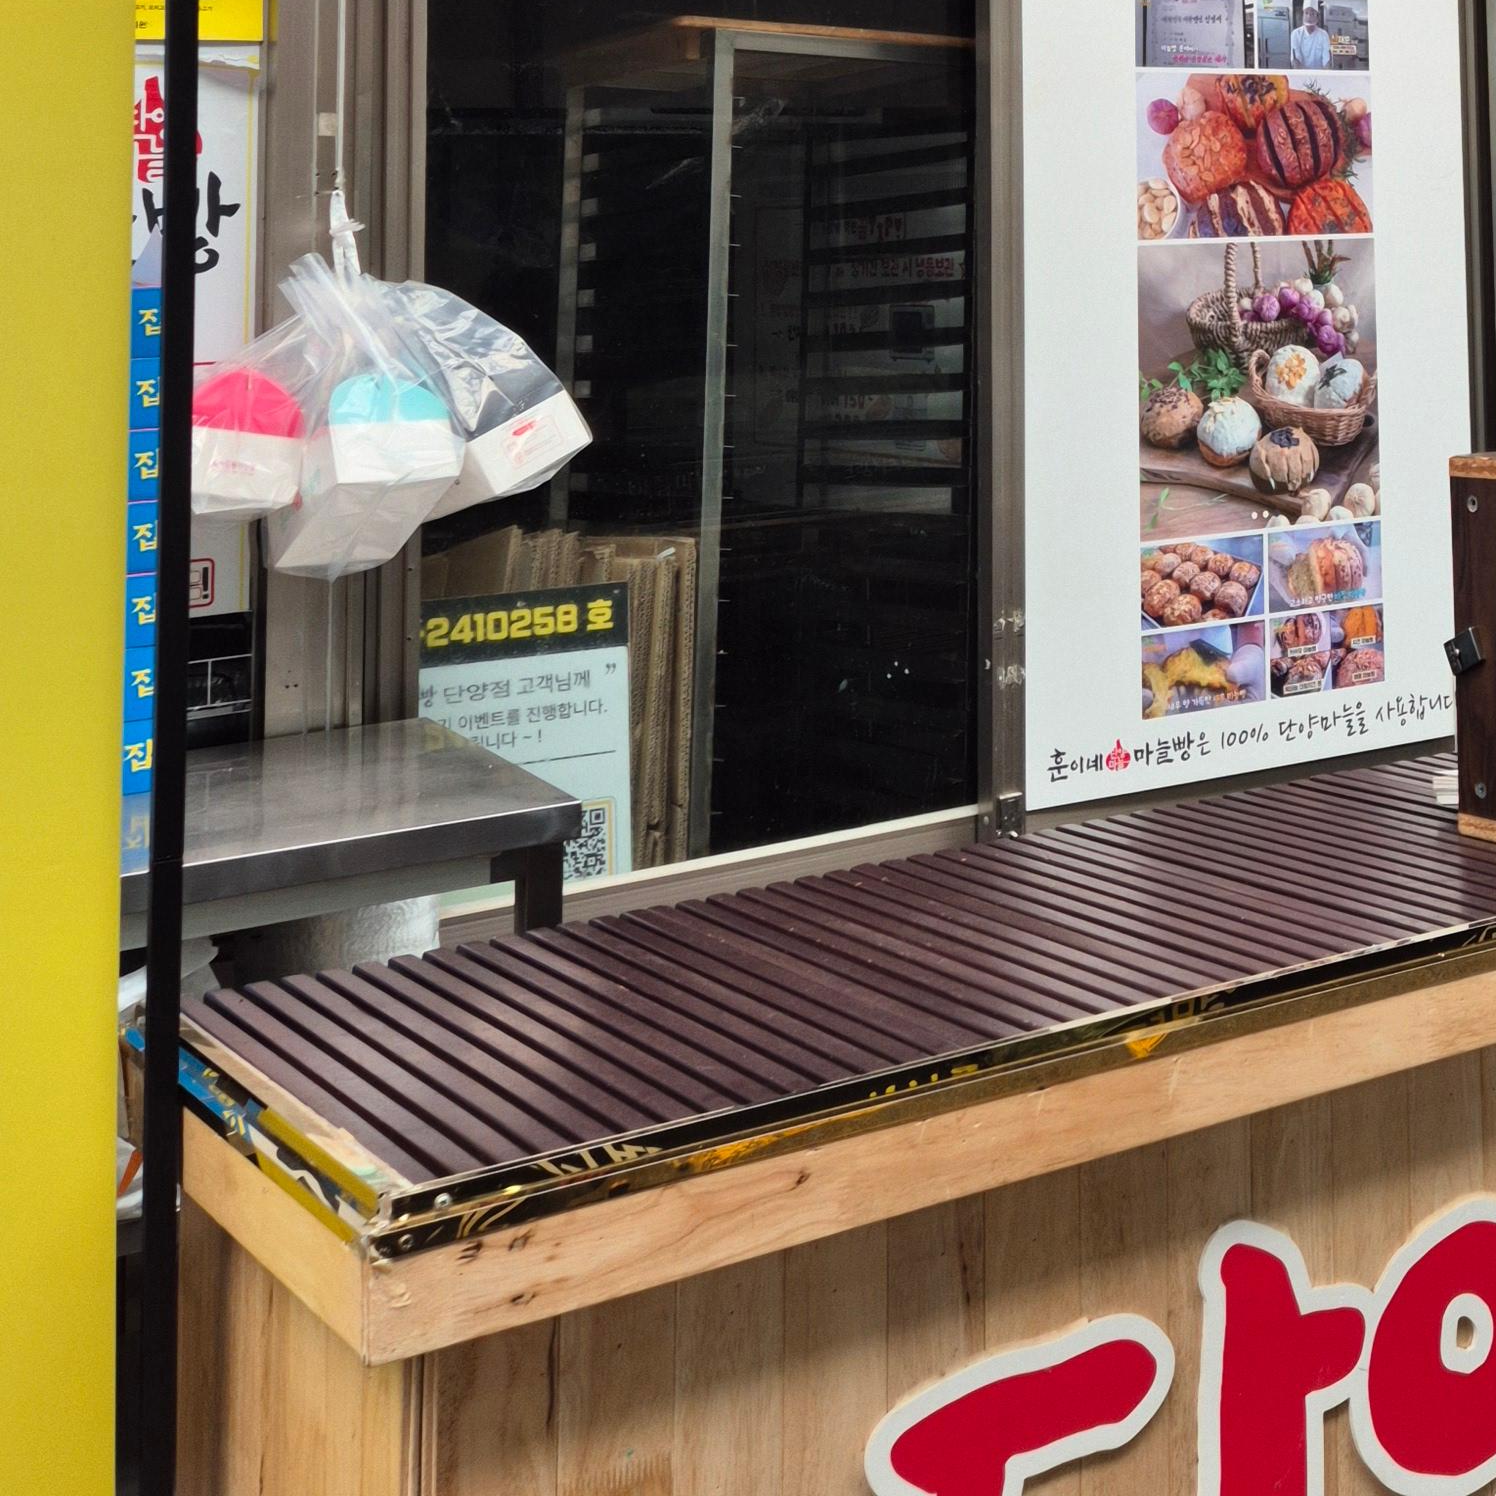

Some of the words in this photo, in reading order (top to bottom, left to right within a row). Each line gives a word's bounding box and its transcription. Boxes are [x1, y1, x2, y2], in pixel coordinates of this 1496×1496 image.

[586, 598, 614, 632] 호
[443, 679, 511, 705] 단양점
[516, 668, 591, 697] 고객님께
[457, 709, 521, 731] 이벤트를
[527, 698, 608, 721] 진행합니다.
[1046, 747, 1104, 783] 훈이네
[1132, 730, 1211, 766] 마늘빵은
[1219, 722, 1269, 749] 100%
[1278, 701, 1370, 742] 단양마늘을
